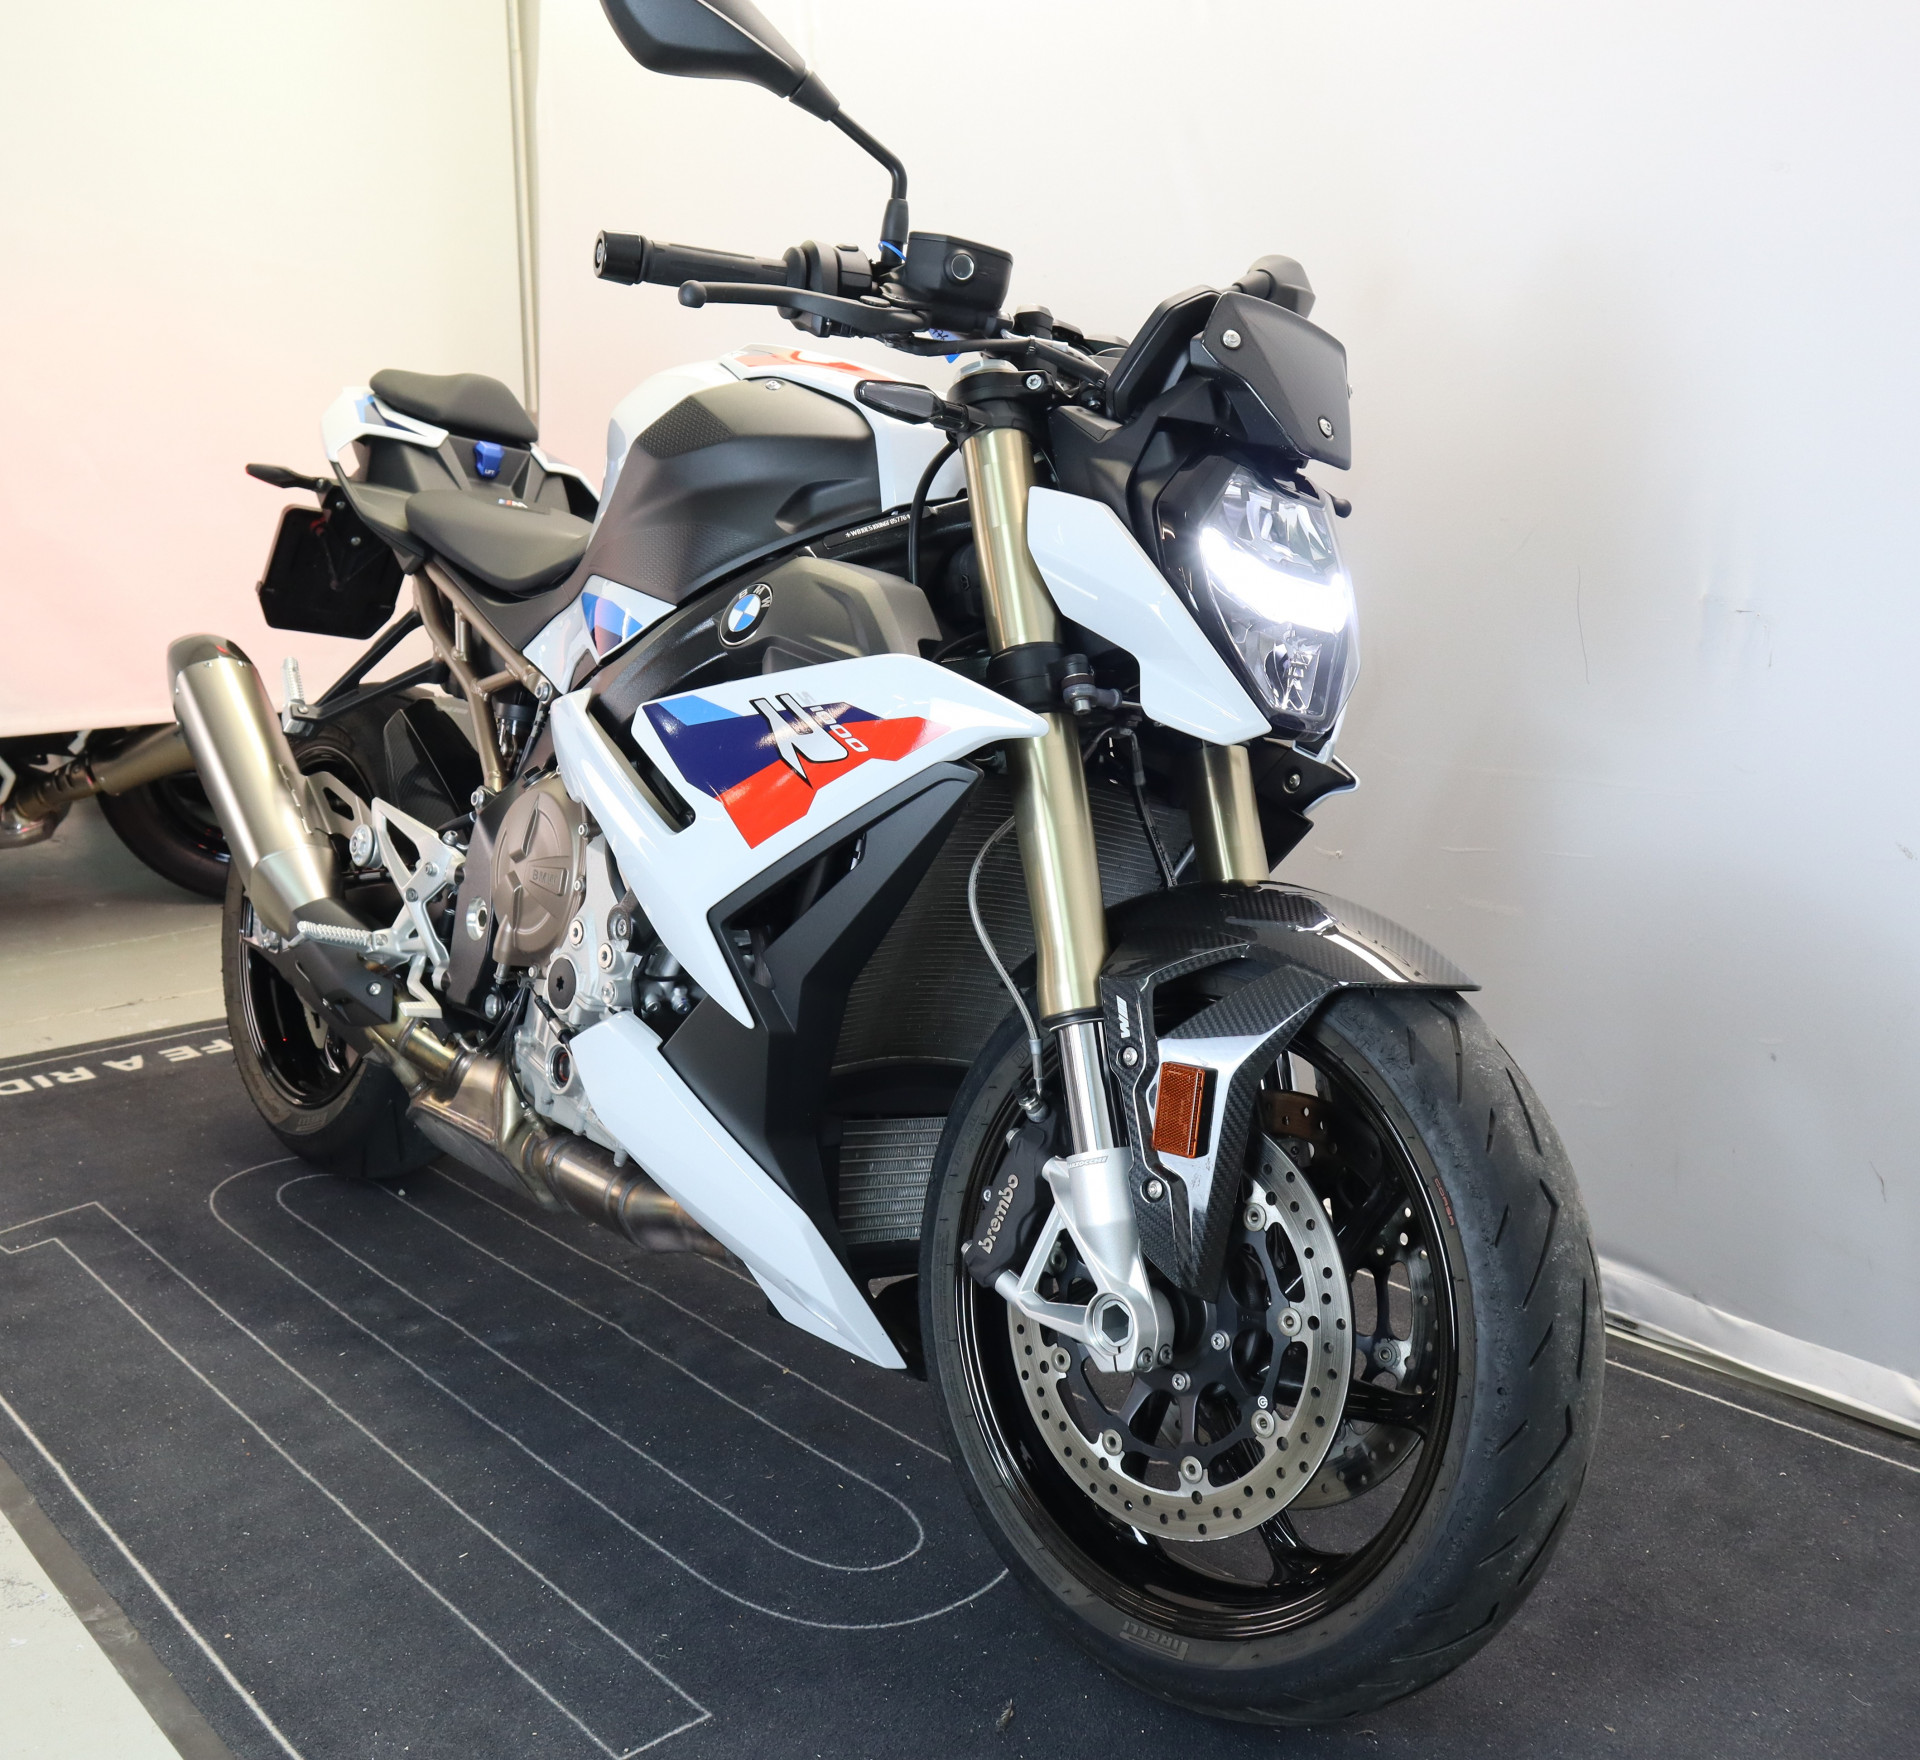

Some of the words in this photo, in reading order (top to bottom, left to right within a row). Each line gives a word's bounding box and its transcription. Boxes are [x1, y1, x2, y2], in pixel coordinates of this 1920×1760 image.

[737, 584, 772, 608] BMW
[101, 1054, 144, 1072] A
[978, 1173, 1019, 1254] brembo
[1434, 1177, 1455, 1226] CORSA
[1119, 1620, 1190, 1661] PIRELLI
